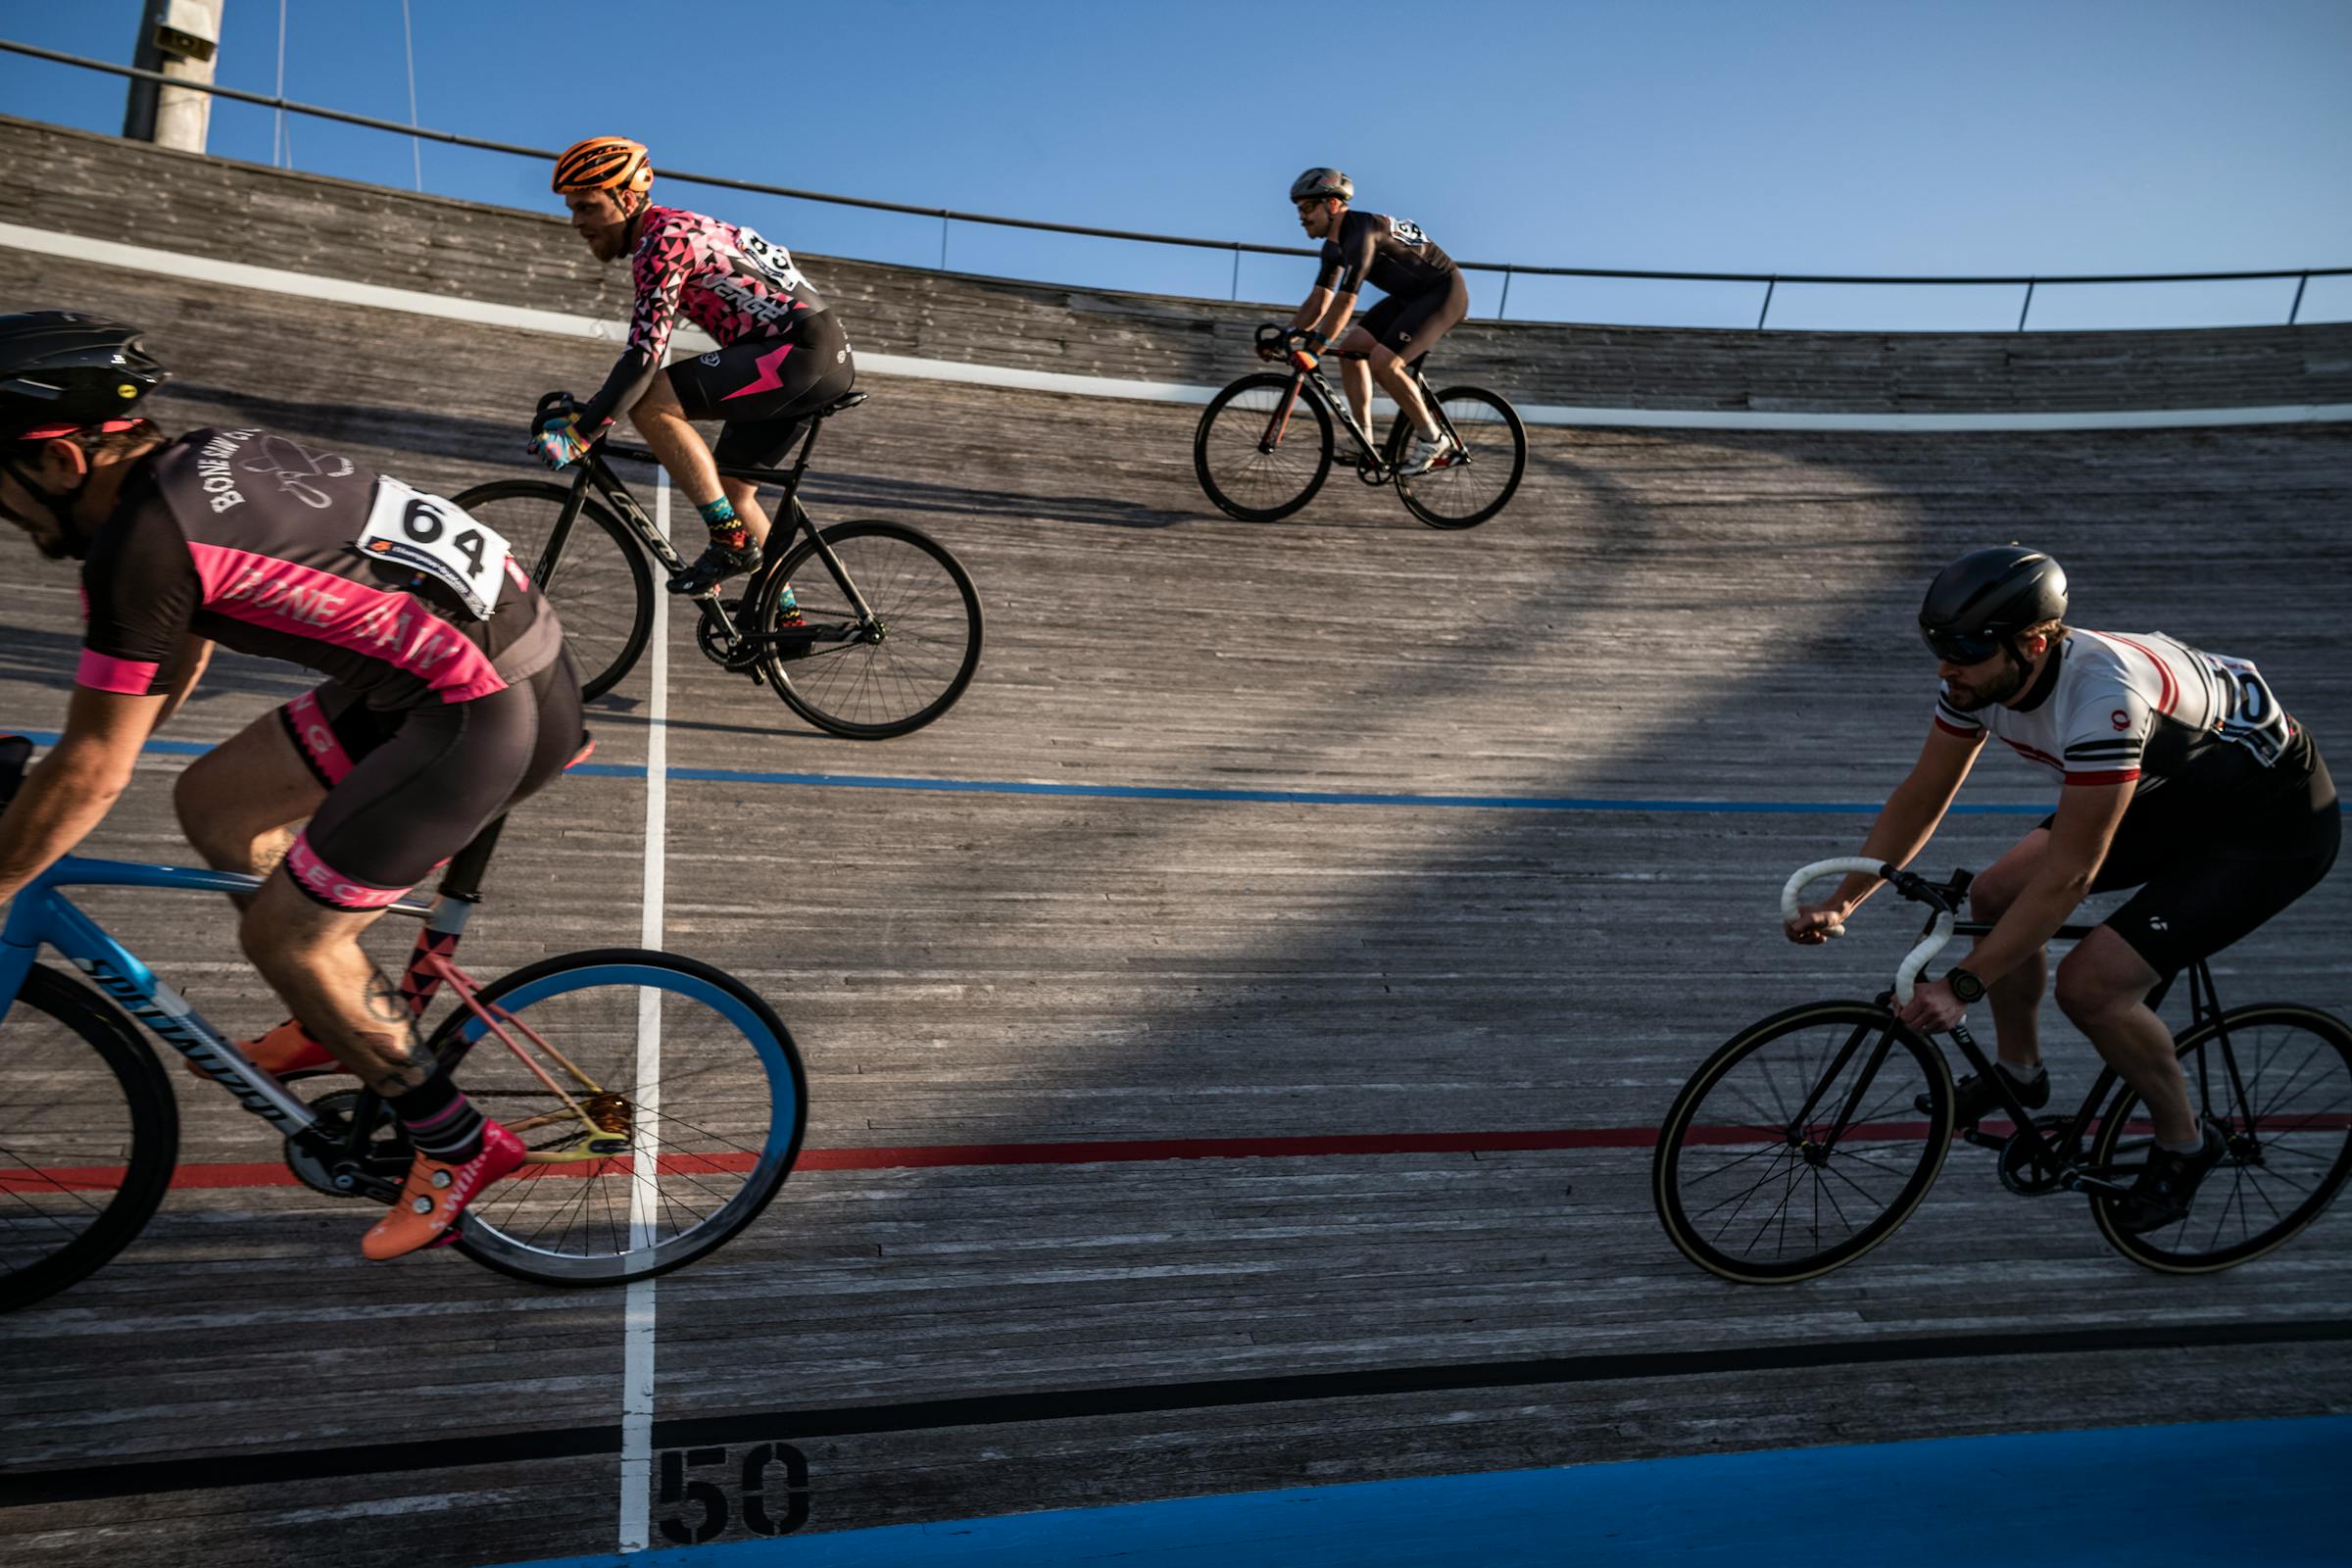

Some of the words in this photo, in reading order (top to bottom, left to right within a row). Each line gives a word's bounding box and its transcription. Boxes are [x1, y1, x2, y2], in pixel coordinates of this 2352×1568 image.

[197, 460, 245, 514] BONE
[404, 499, 485, 580] 64
[221, 565, 345, 628] BONE
[354, 606, 460, 670] SAW
[84, 958, 287, 1122] SPECIALIZED
[658, 1441, 810, 1545] 50
